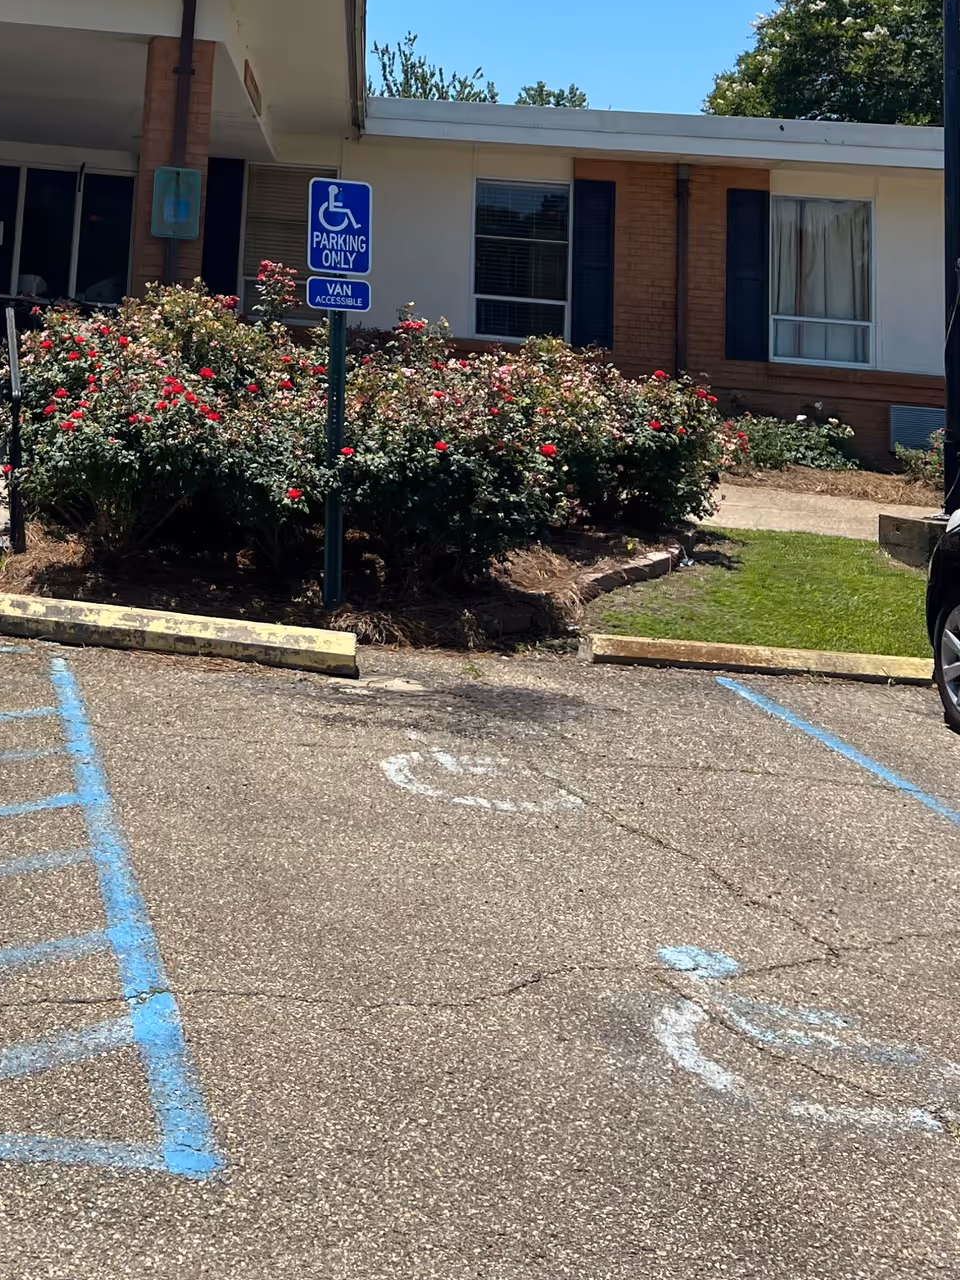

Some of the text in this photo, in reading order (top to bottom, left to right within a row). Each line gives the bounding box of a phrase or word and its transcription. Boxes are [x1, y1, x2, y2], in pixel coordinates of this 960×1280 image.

[313, 232, 366, 252] PARKING
[322, 250, 356, 268] ONLY
[327, 283, 351, 296] VAN
[315, 295, 363, 306] ACCESSIBLE
